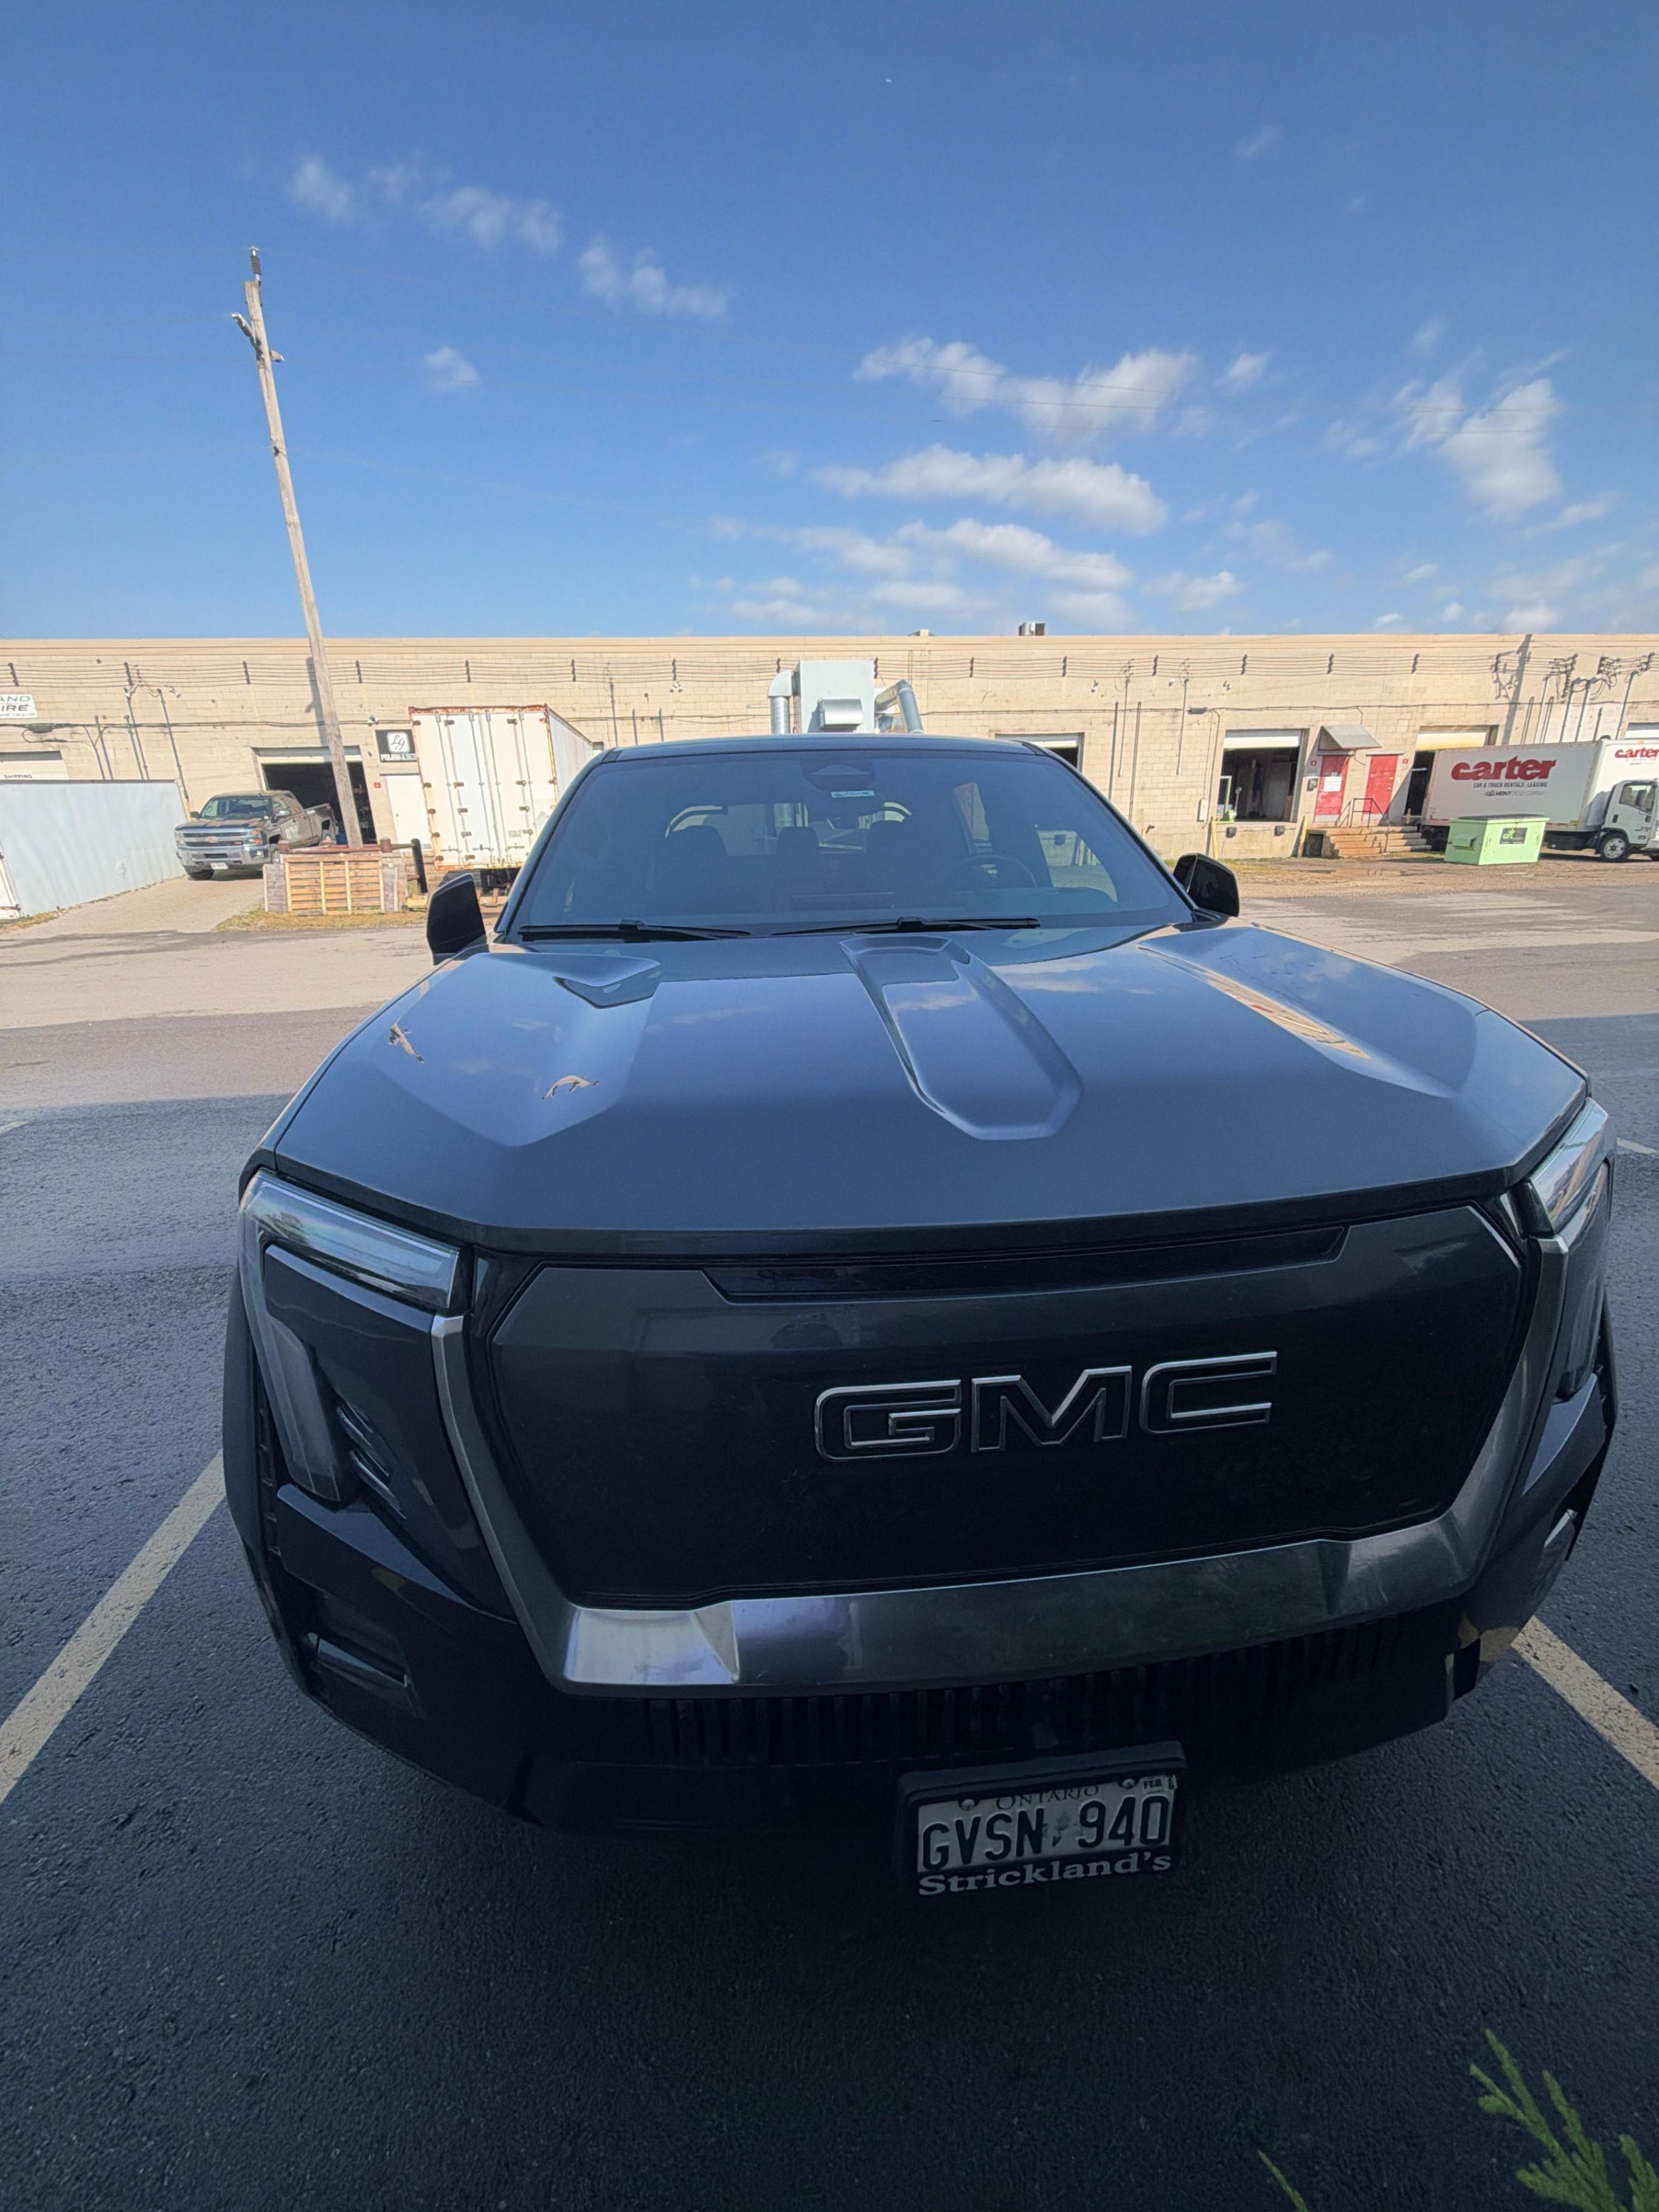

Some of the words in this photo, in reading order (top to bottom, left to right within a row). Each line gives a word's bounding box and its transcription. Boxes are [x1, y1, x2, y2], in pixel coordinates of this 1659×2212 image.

[1615, 747, 1659, 758] carter
[1451, 756, 1557, 781] carter
[815, 1351, 1278, 1460] GMC
[1144, 1779, 1162, 1789] FEB
[996, 1785, 1100, 1810] ONTARIO
[923, 1808, 1044, 1870] GVSN
[1078, 1795, 1169, 1848] 940
[919, 1851, 1171, 1896] Strickland's
